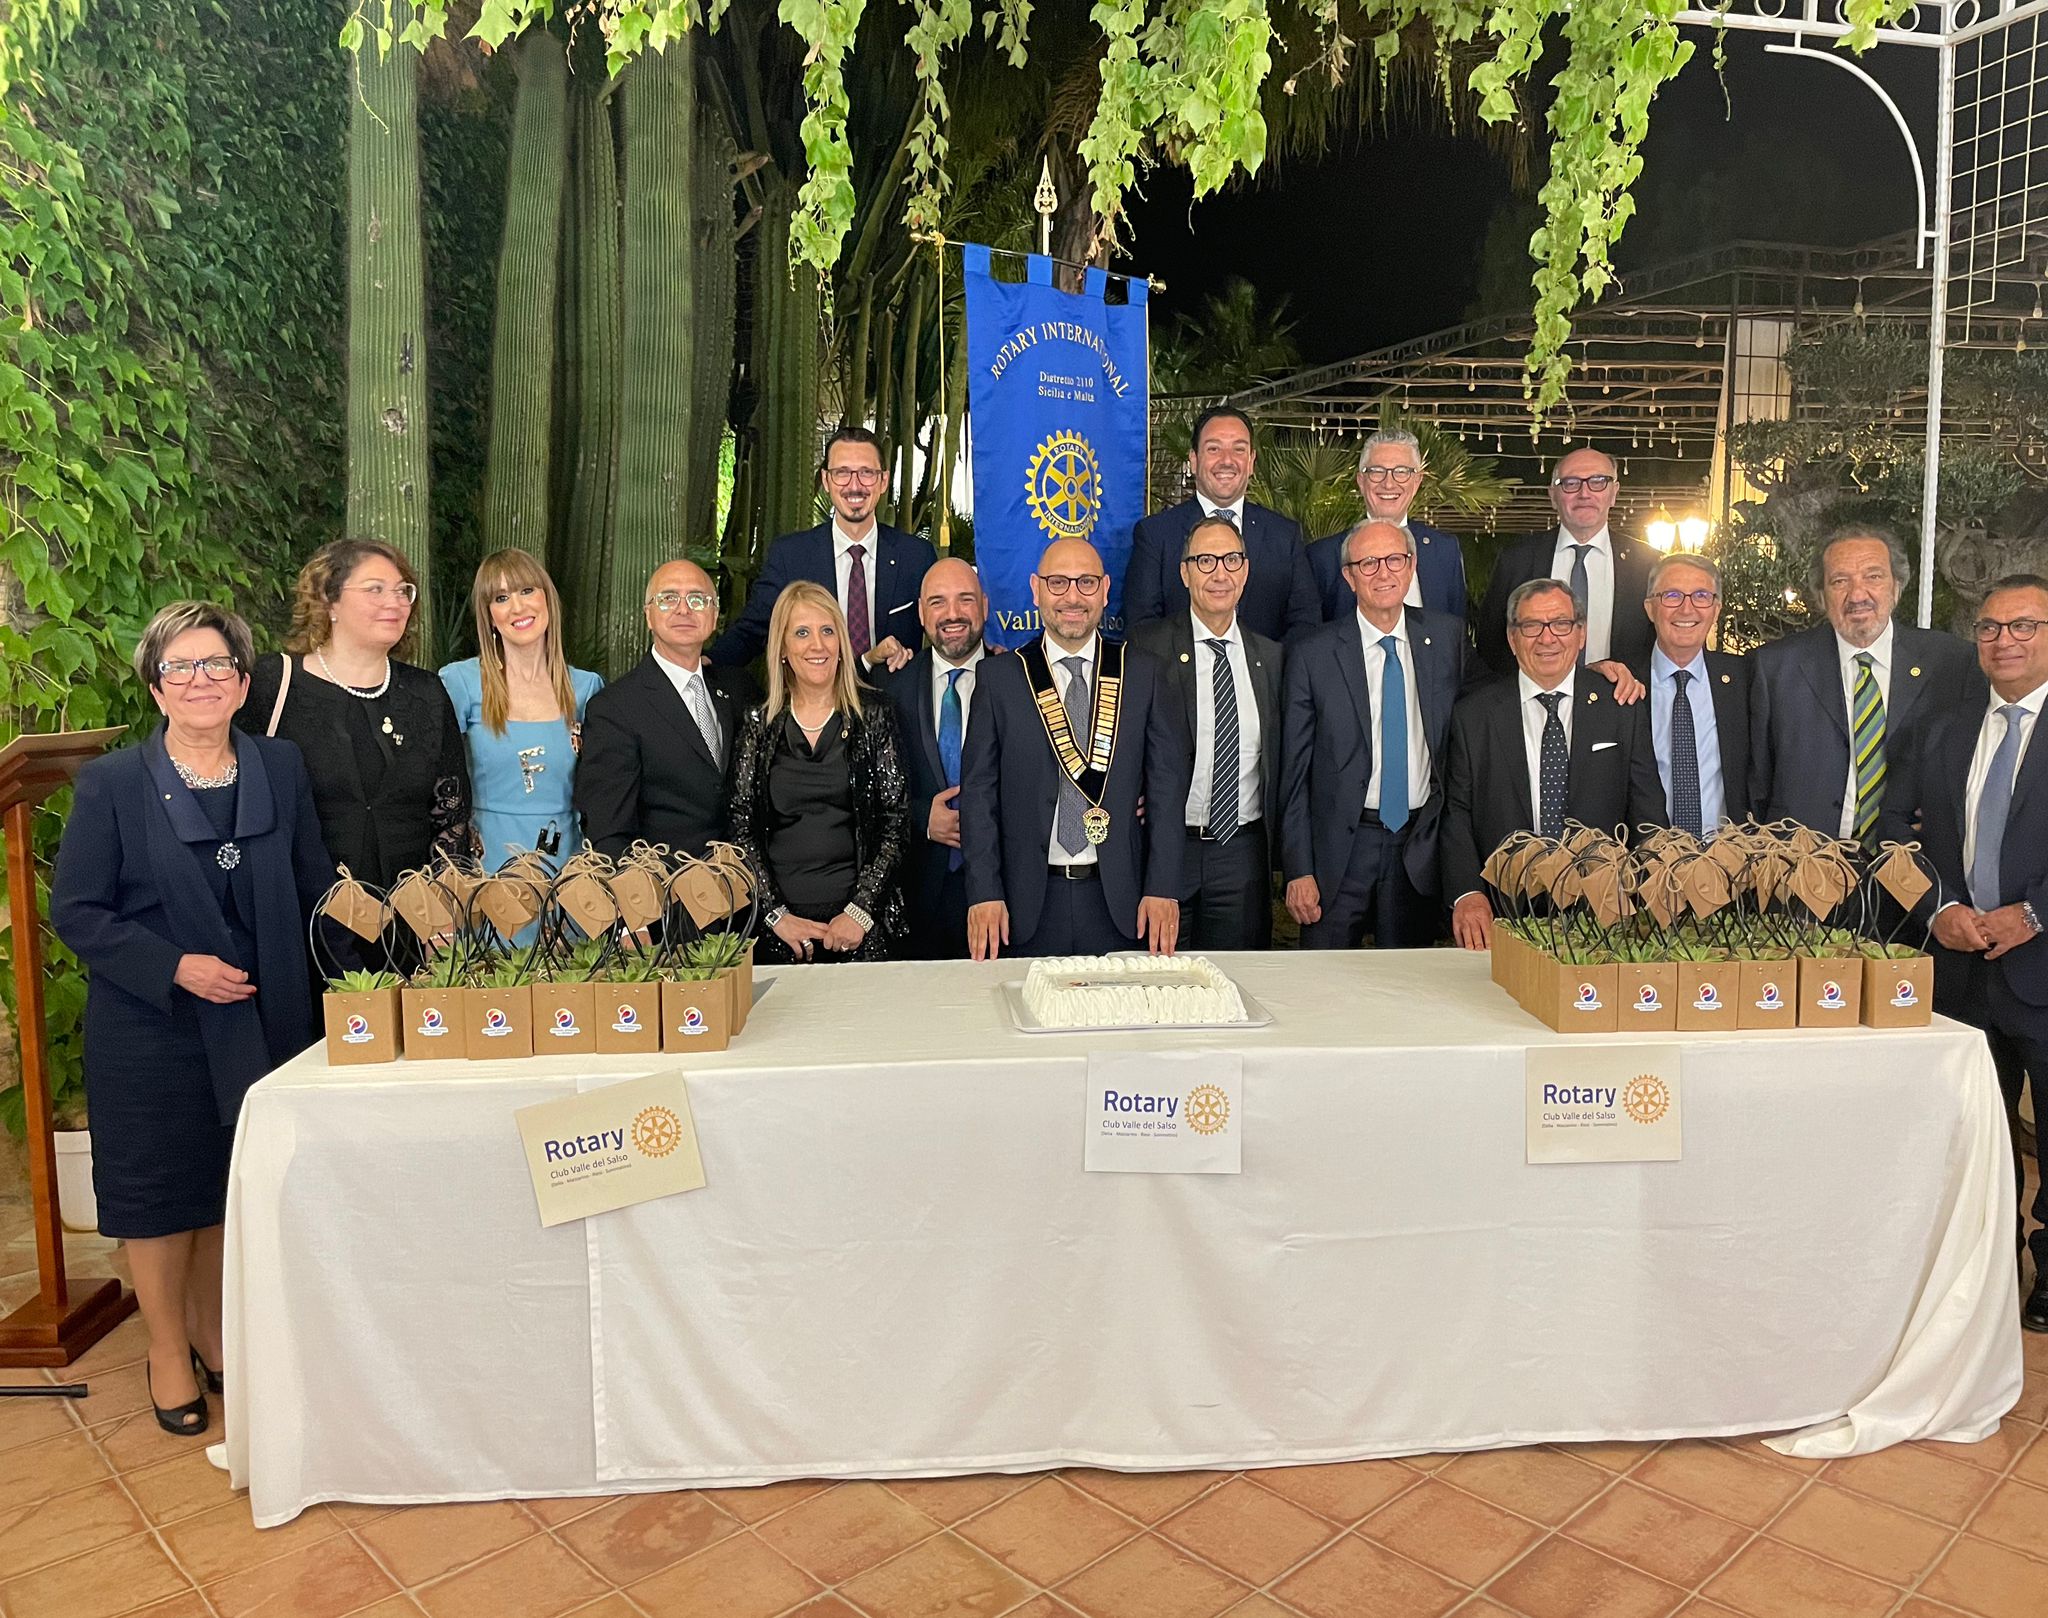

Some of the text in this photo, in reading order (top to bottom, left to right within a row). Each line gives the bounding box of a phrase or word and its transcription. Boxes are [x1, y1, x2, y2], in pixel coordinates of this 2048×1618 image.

[990, 321, 1129, 398] ROTARY INTERNATONAL
[1038, 385, 1095, 402] Sicilia e Malta
[1076, 376, 1094, 388] 2110
[1053, 443, 1085, 456] ROTARY
[995, 609, 1042, 632] Vall
[1103, 1090, 1179, 1118] Rotary
[1543, 1083, 1617, 1108] Rotary
[1102, 1120, 1177, 1130] Club Valle del Salso
[1543, 1111, 1616, 1120] Club Valle del Salso
[544, 1128, 623, 1163] Rotary
[550, 1168, 569, 1179] Club
[570, 1163, 591, 1174] Valle
[592, 1158, 605, 1168] del
[606, 1154, 628, 1165] Salso
